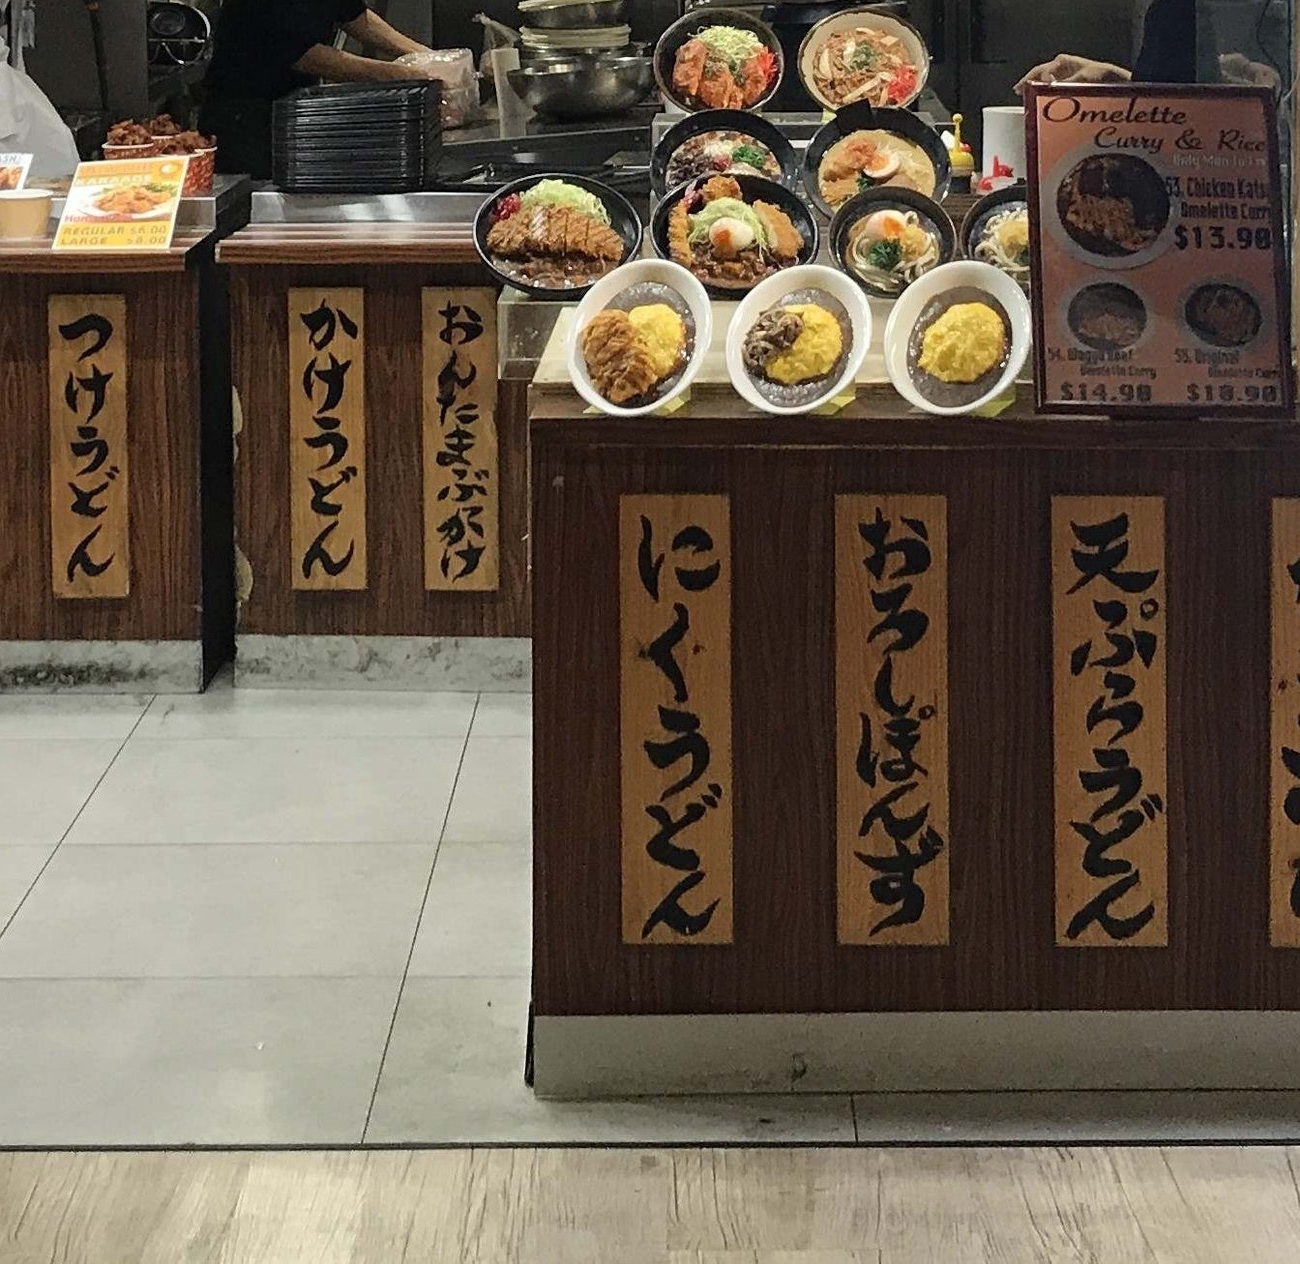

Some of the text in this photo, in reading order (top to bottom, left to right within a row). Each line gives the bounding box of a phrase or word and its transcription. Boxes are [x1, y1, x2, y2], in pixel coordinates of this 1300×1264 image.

[1042, 95, 1188, 124] Omelette
[1094, 125, 1266, 155] Curry & Rice
[61, 236, 108, 245] LARGE
[63, 225, 125, 235] REGULAR
[1174, 224, 1271, 250] $13.90
[1059, 382, 1151, 403] $14.90
[57, 313, 119, 583] つけうどん
[300, 298, 358, 580] かけうどん
[636, 514, 723, 939] にくうどん
[854, 506, 945, 936] おろしぽんず
[1066, 511, 1165, 942] 天ぷらうどん
